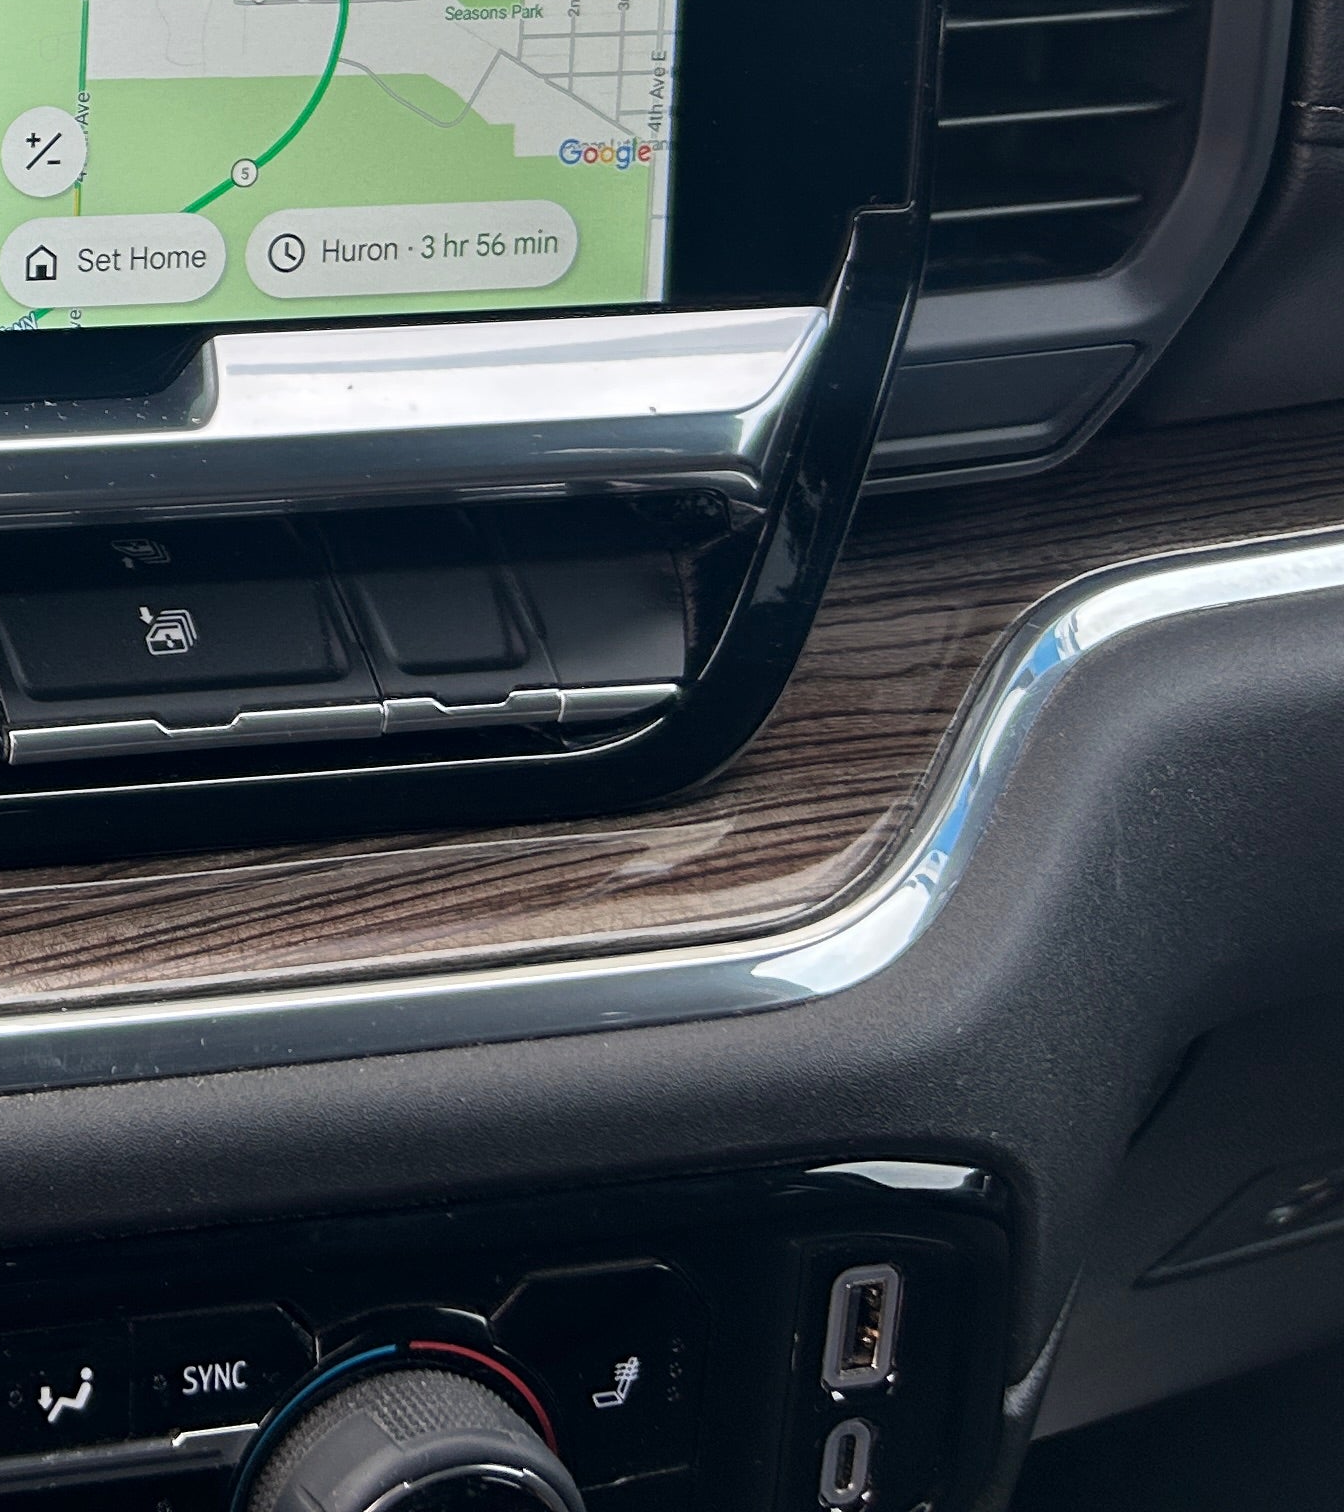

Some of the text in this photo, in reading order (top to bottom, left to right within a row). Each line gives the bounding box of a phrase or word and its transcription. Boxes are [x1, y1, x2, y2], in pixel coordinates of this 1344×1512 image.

[445, 4, 543, 21] Seasons Park
[651, 50, 667, 61] E
[649, 67, 666, 99] Ave
[75, 91, 90, 125] Ave
[647, 104, 663, 133] 4th
[559, 138, 653, 170] Google
[240, 167, 250, 180] 5
[77, 246, 207, 272] Set Home
[322, 238, 398, 263] Huron
[421, 235, 435, 259] 3
[443, 233, 469, 258] hr
[476, 232, 506, 257] 56
[514, 229, 559, 255] min
[181, 1360, 248, 1396] SYNC
